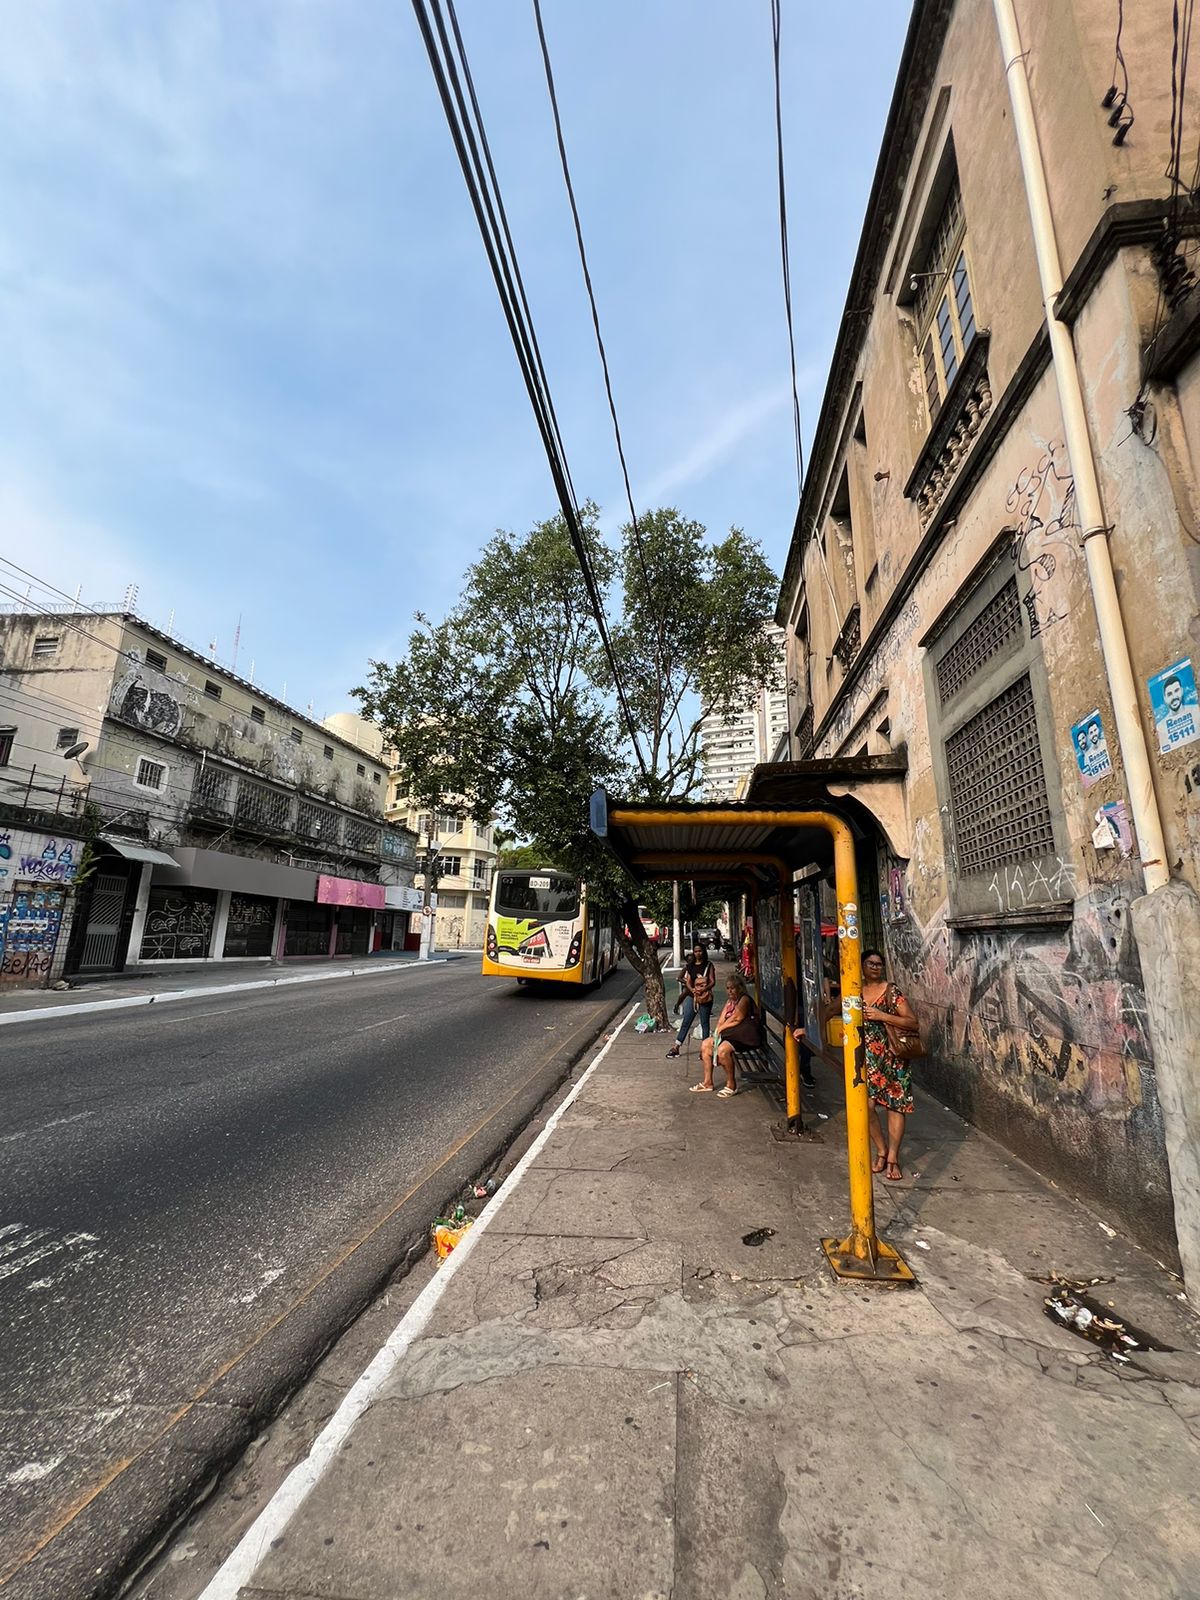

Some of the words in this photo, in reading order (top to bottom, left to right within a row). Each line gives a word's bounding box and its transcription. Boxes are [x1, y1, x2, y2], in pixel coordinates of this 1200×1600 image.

[1166, 713, 1192, 728] Renan
[1168, 725, 1195, 742] 15111
[1088, 749, 1106, 762] Renan
[1092, 759, 1110, 776] 15111
